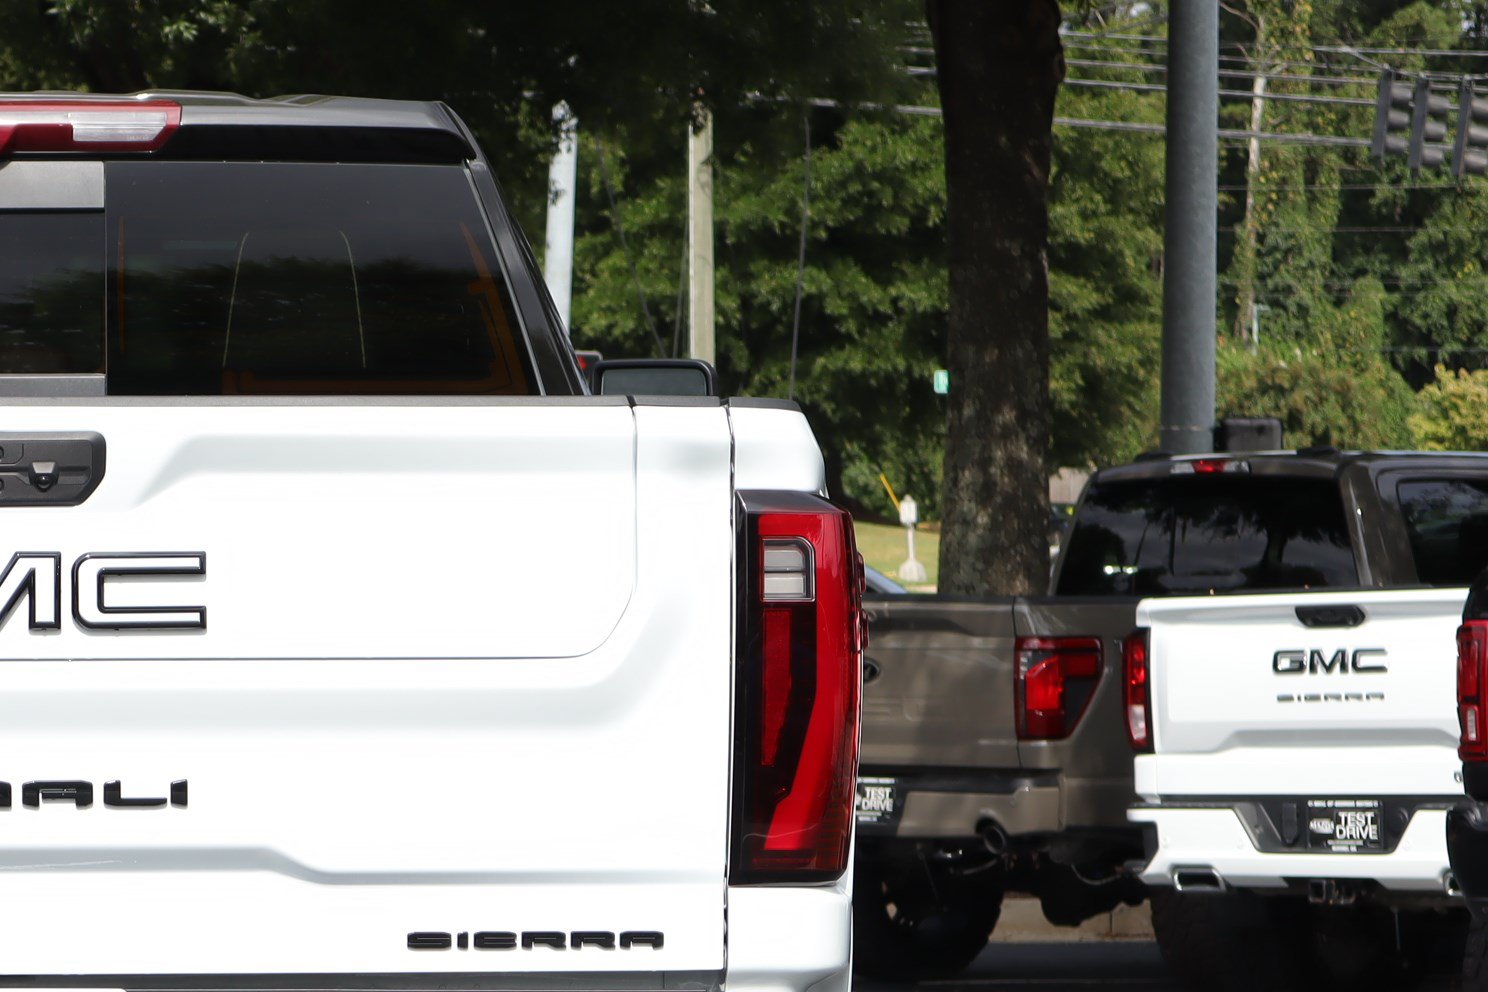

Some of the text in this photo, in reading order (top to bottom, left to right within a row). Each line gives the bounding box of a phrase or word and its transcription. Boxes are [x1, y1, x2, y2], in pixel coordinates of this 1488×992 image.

[1272, 648, 1388, 674] GMC
[865, 786, 892, 800] TEST
[862, 798, 894, 812] DRIVE
[1338, 811, 1375, 828] TEST
[1335, 824, 1379, 840] DRIVE
[406, 931, 665, 951] SIERRA
